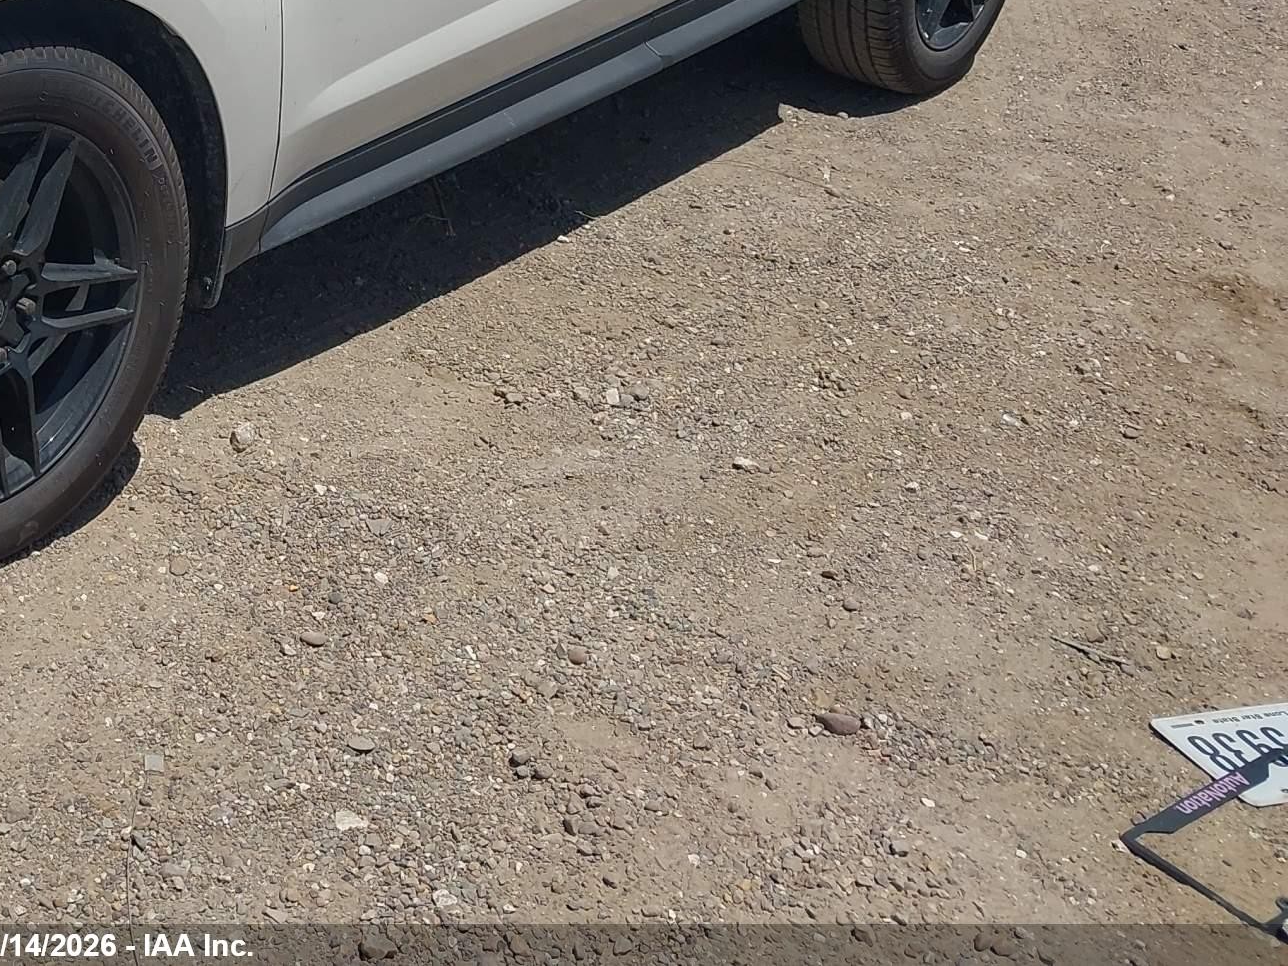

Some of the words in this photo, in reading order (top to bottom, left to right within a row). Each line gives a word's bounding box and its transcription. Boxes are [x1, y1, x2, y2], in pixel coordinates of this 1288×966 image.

[1212, 716, 1240, 724] State
[1242, 713, 1264, 721] Star
[1175, 772, 1250, 814] AutoNation
